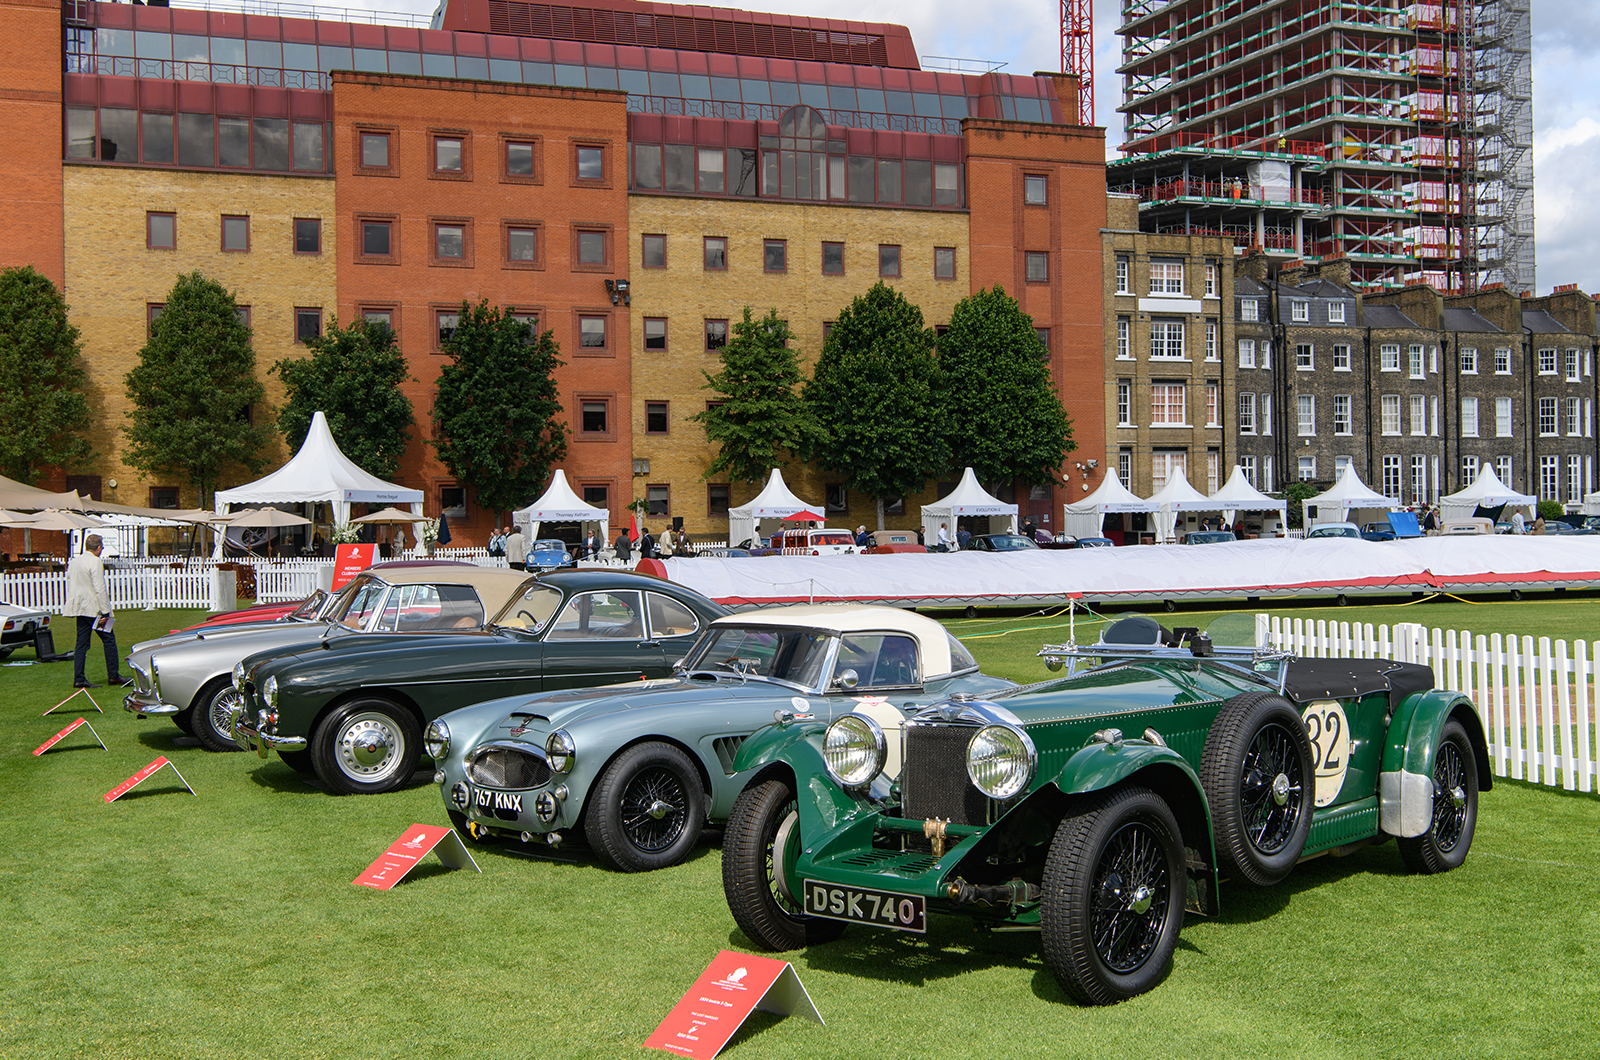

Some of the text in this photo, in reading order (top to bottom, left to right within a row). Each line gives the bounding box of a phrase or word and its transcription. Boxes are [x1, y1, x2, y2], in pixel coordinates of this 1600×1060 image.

[1304, 710, 1341, 770] 32
[474, 788, 522, 812] 767 KNX
[813, 885, 915, 925] DSK740
